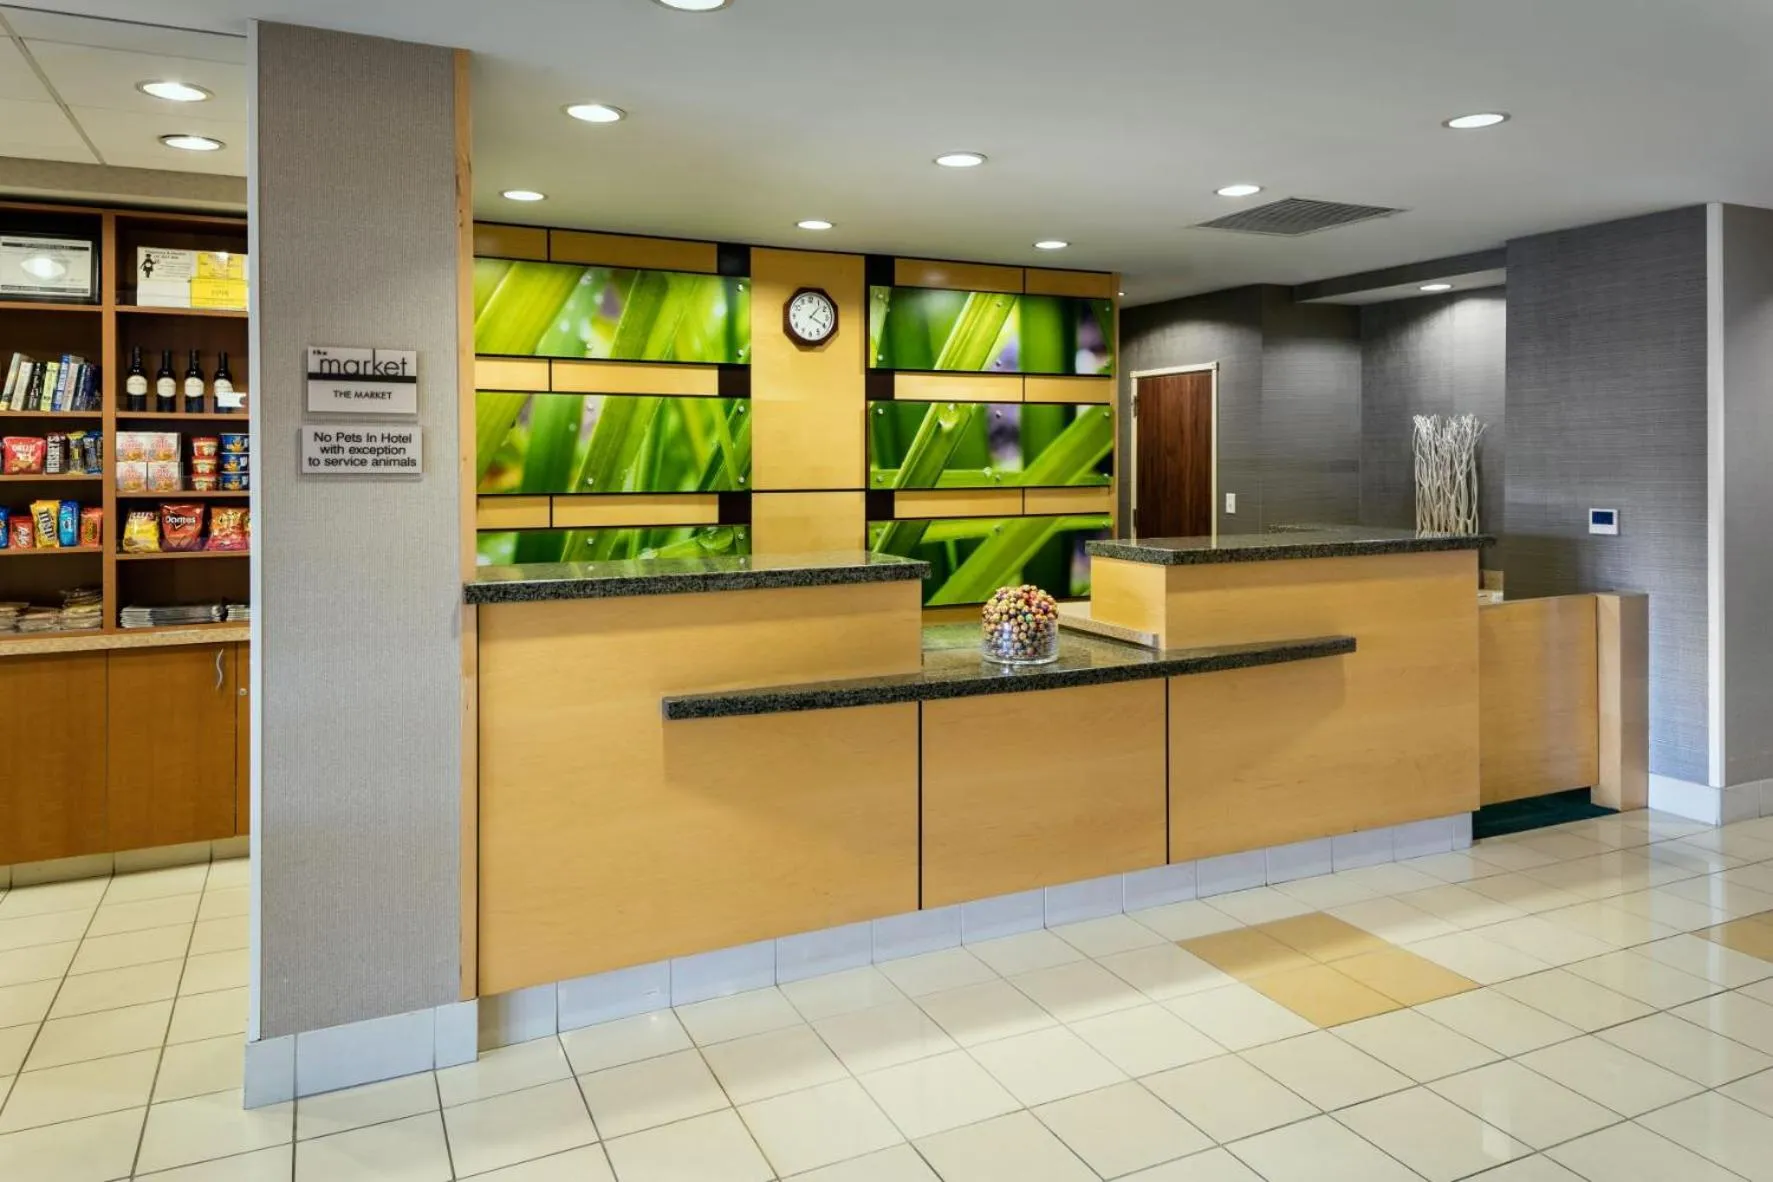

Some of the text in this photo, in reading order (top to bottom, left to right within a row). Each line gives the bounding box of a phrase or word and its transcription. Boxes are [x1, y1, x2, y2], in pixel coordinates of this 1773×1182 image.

[319, 348, 408, 376] market
[333, 389, 392, 399] THE MARKET
[313, 431, 412, 444] No Pets In Hotel
[320, 443, 406, 457] with exception
[308, 456, 417, 467] to service animals
